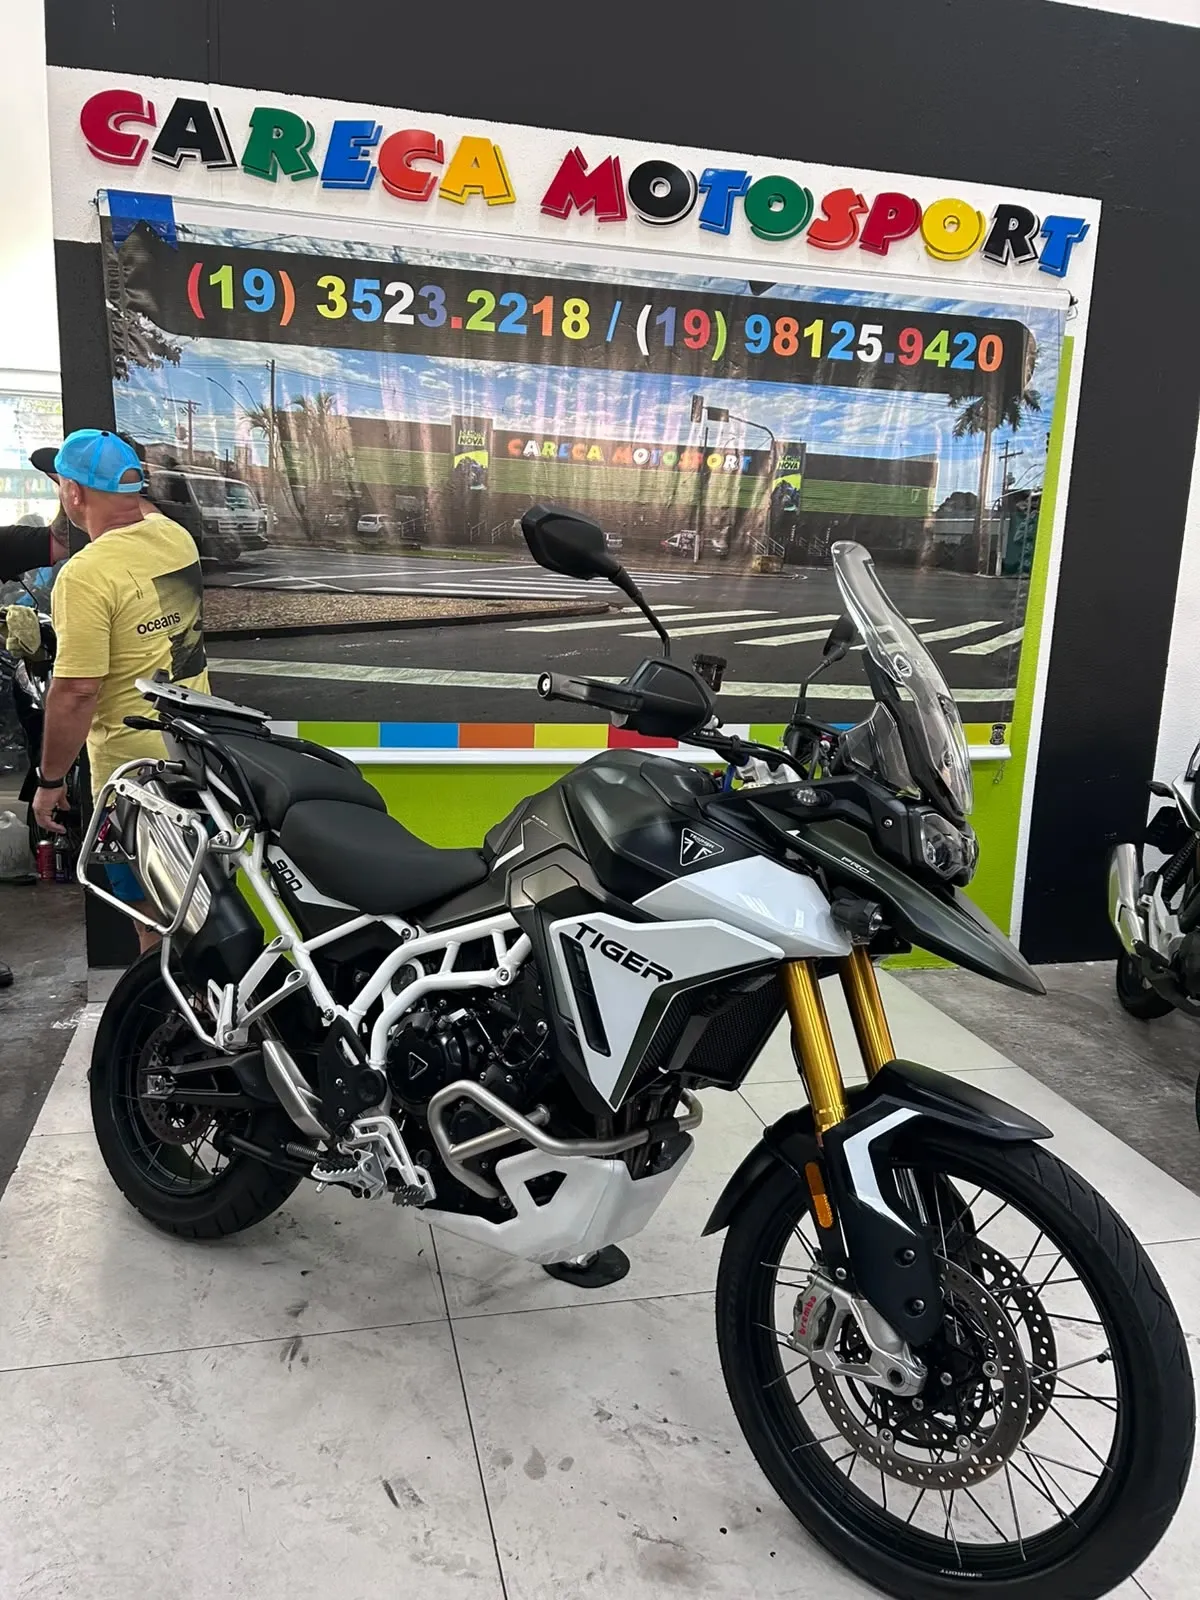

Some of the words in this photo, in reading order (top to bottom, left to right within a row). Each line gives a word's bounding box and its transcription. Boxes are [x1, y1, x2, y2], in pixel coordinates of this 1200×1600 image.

[80, 89, 516, 206] CARECA
[540, 146, 1090, 278] MOTOSPORT
[187, 263, 295, 326] (19)
[316, 275, 590, 340] 3523.2218
[605, 301, 622, 342] /
[636, 304, 727, 361] (19)
[744, 312, 1003, 372] 98125.9420
[507, 438, 604, 461] CARECA
[137, 612, 181, 635] oceans
[276, 859, 303, 891] 900
[841, 856, 870, 874] PRO
[574, 922, 674, 983] TIGER
[799, 1295, 817, 1336] brembo
